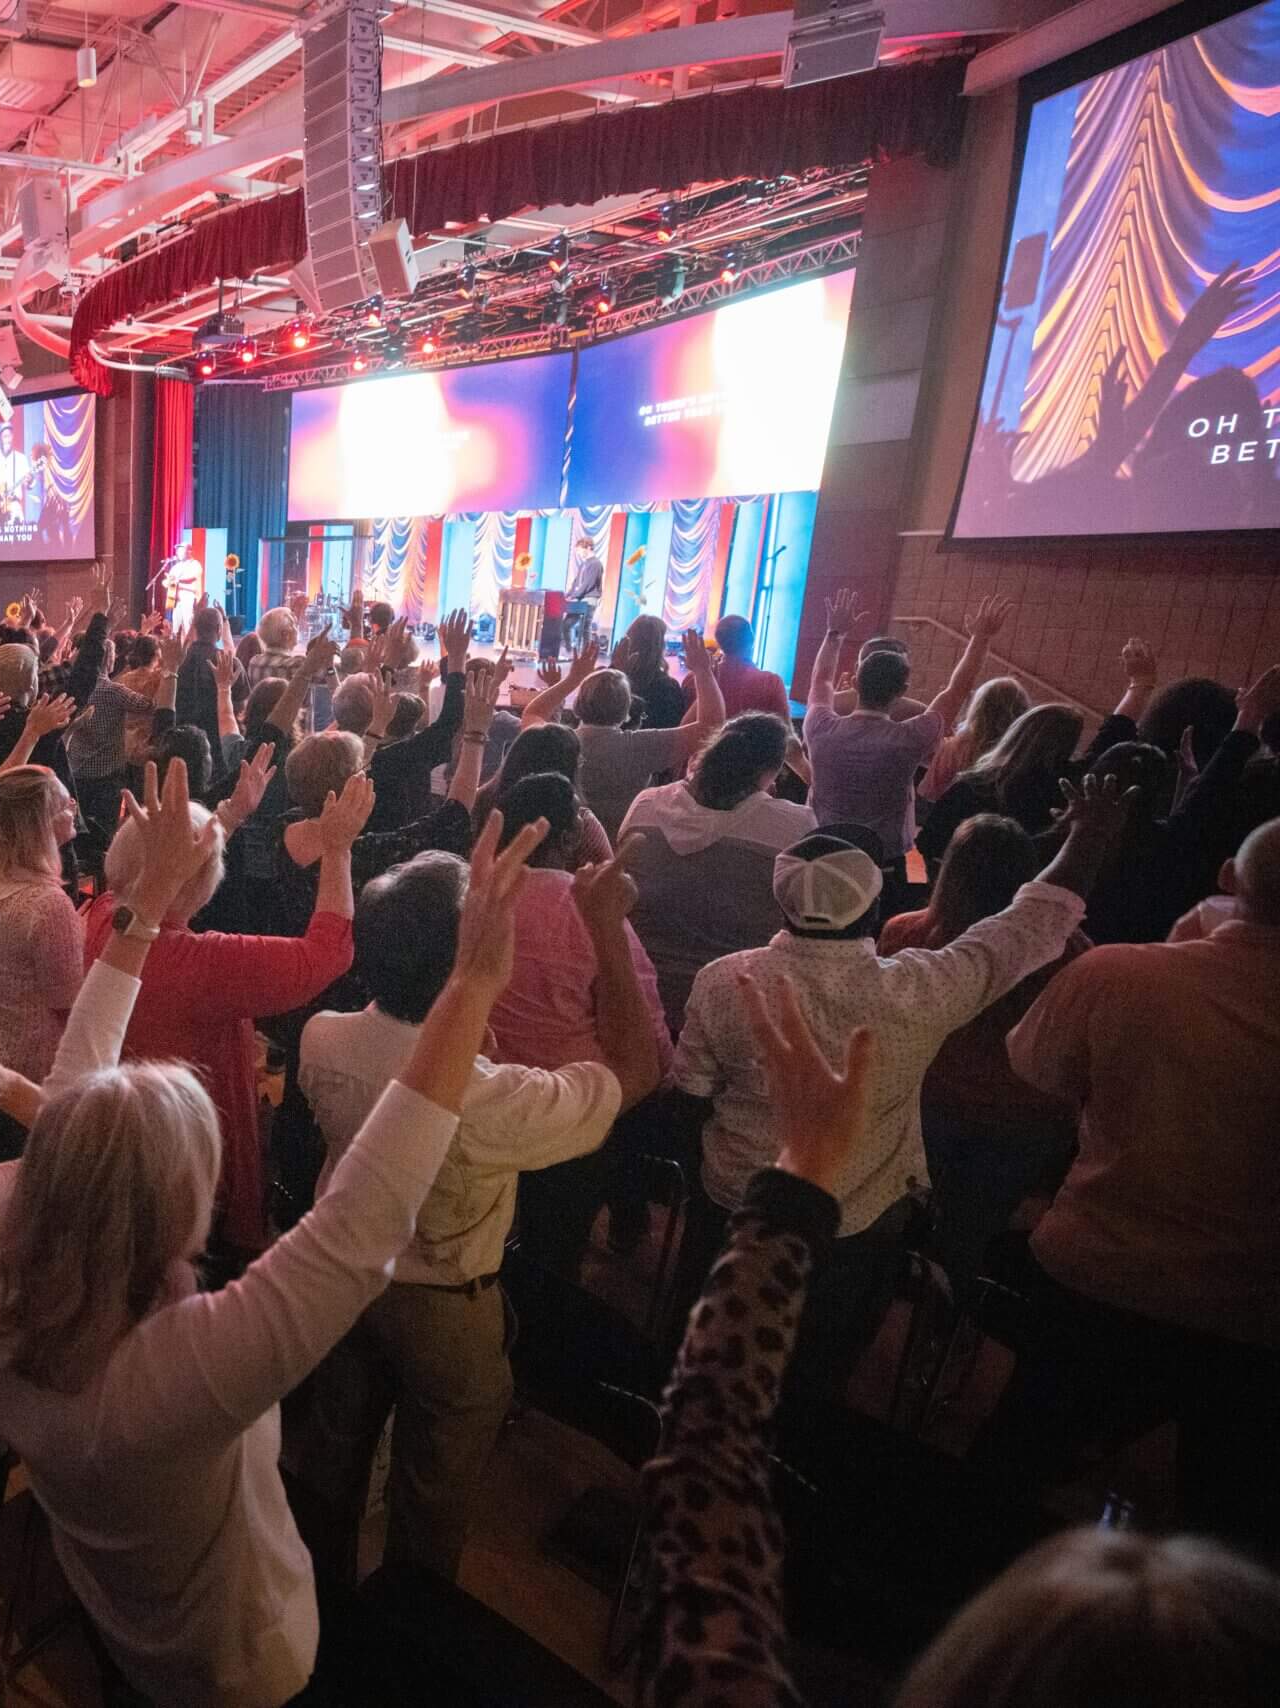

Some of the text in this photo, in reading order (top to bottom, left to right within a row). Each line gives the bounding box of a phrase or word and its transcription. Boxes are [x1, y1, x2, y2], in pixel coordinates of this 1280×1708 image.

[1188, 413, 1238, 438] OH
[1211, 439, 1280, 464] BET
[4, 525, 38, 533] NOTHING
